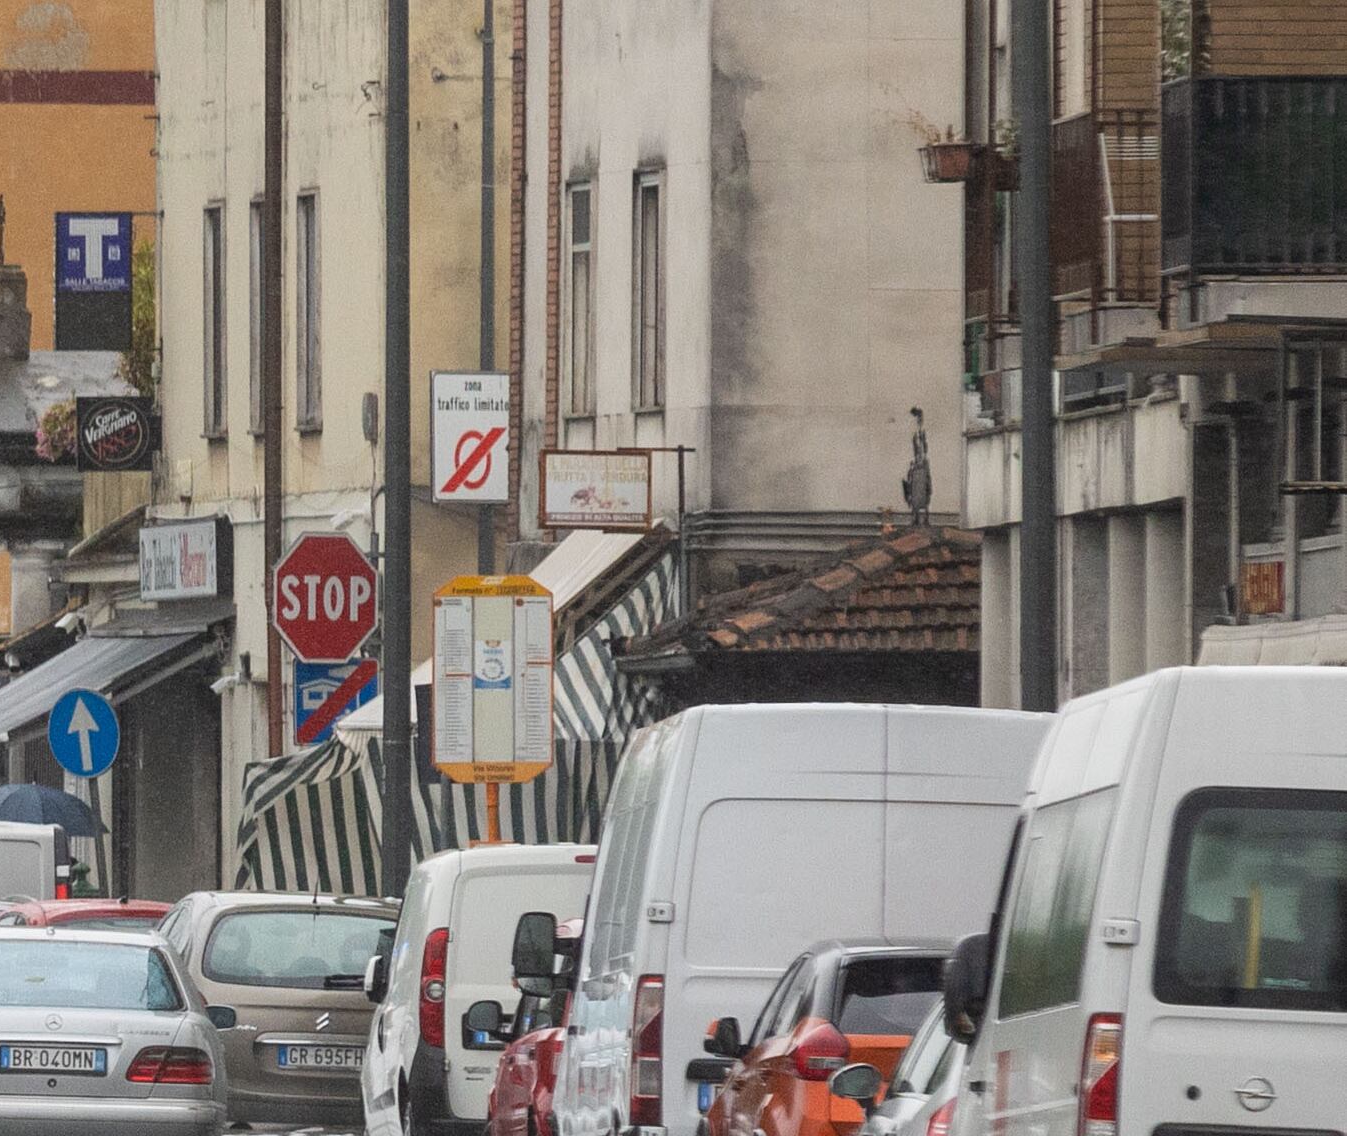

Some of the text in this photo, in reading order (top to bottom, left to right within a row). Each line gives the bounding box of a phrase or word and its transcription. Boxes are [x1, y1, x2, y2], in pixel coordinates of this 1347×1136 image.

[68, 218, 119, 279] T
[464, 381, 482, 392] zona
[438, 397, 470, 412] traffico
[281, 574, 371, 622] STOP
[12, 1051, 95, 1069] BR 040MN
[289, 1047, 308, 1064] GR
